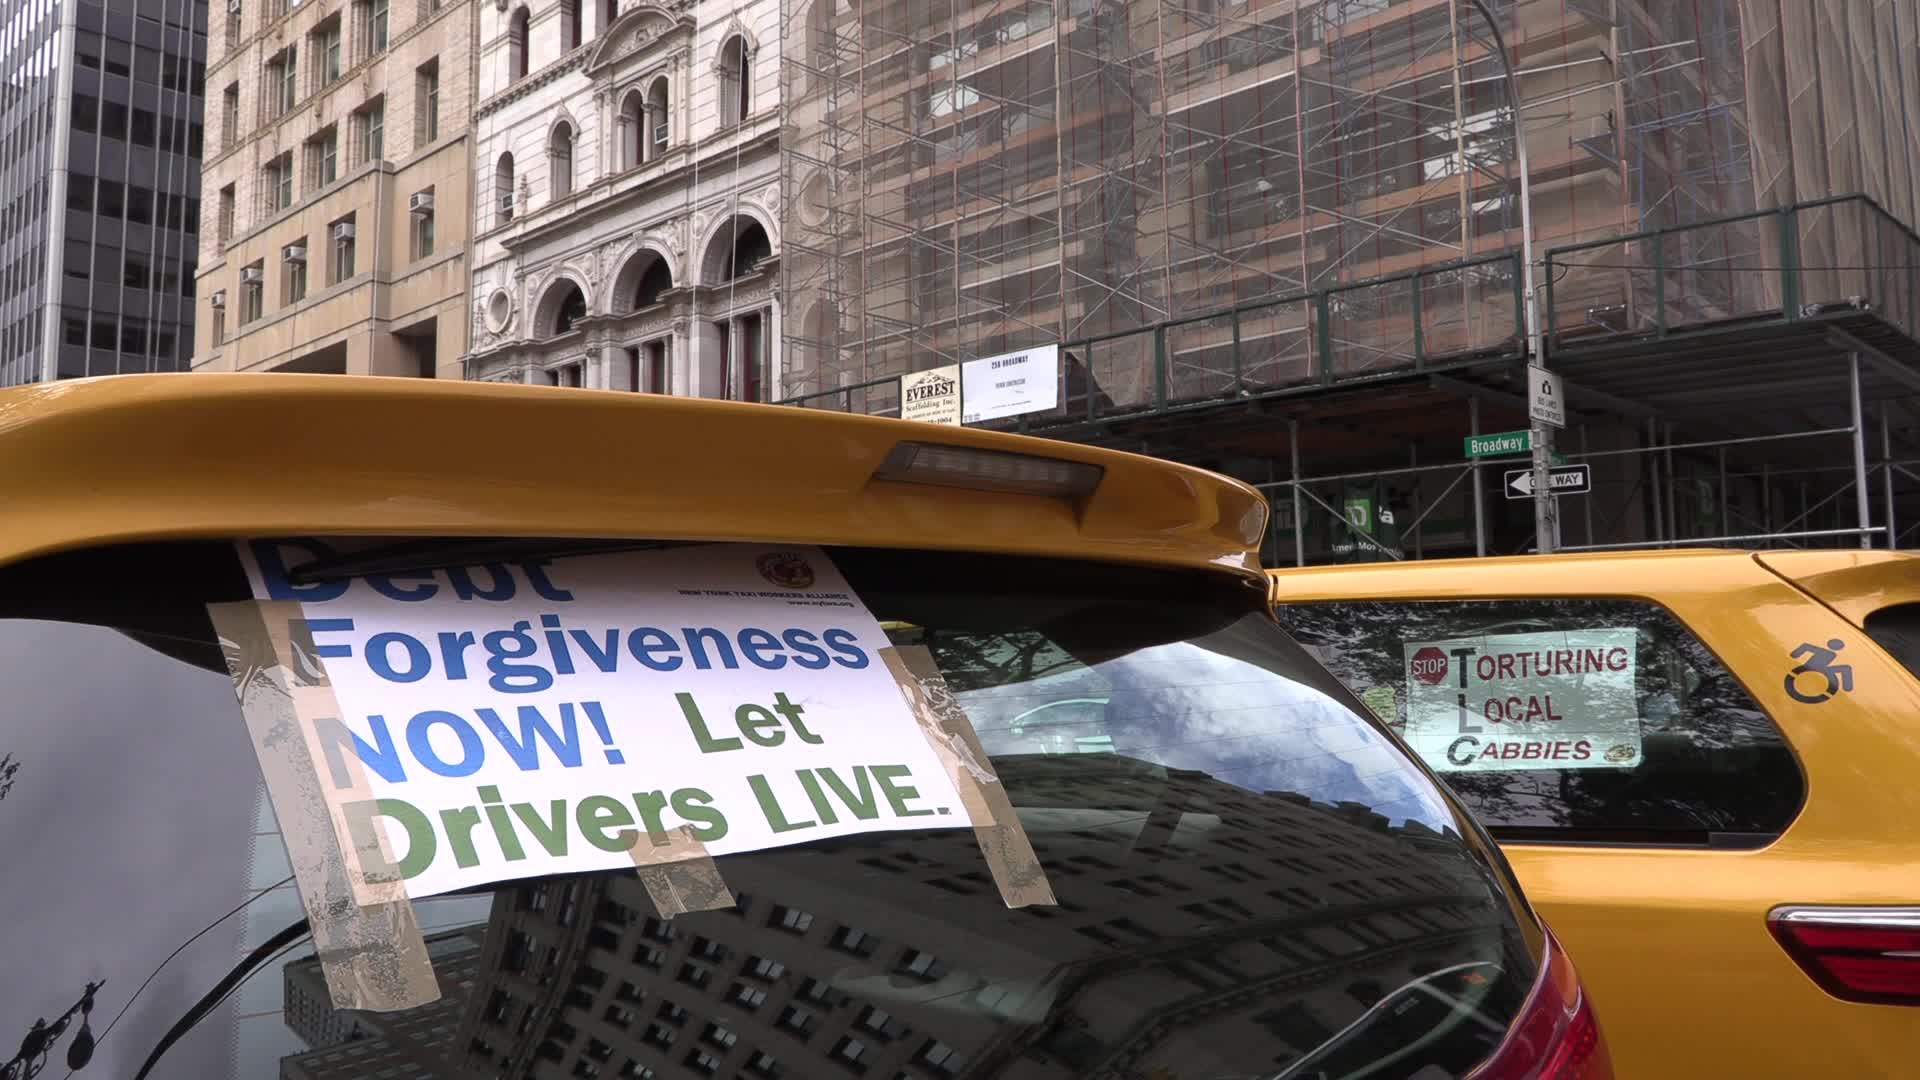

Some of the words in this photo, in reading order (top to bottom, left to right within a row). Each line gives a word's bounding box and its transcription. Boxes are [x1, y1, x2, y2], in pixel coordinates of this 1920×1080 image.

[905, 380, 955, 402] EVEREST
[1471, 434, 1523, 454] Broadway
[1555, 473, 1579, 486] WAY
[805, 592, 850, 601] ALLIANCE
[288, 614, 869, 694] Forgiveness
[1412, 657, 1447, 676] STOP
[1450, 647, 1628, 689] TORTURING
[1457, 693, 1563, 734] LOCAL
[312, 701, 626, 790] NOW!
[675, 690, 825, 755] Let
[1446, 735, 1593, 767] CABBIES
[342, 784, 729, 887] Drivers
[746, 763, 952, 835] LIVE.
